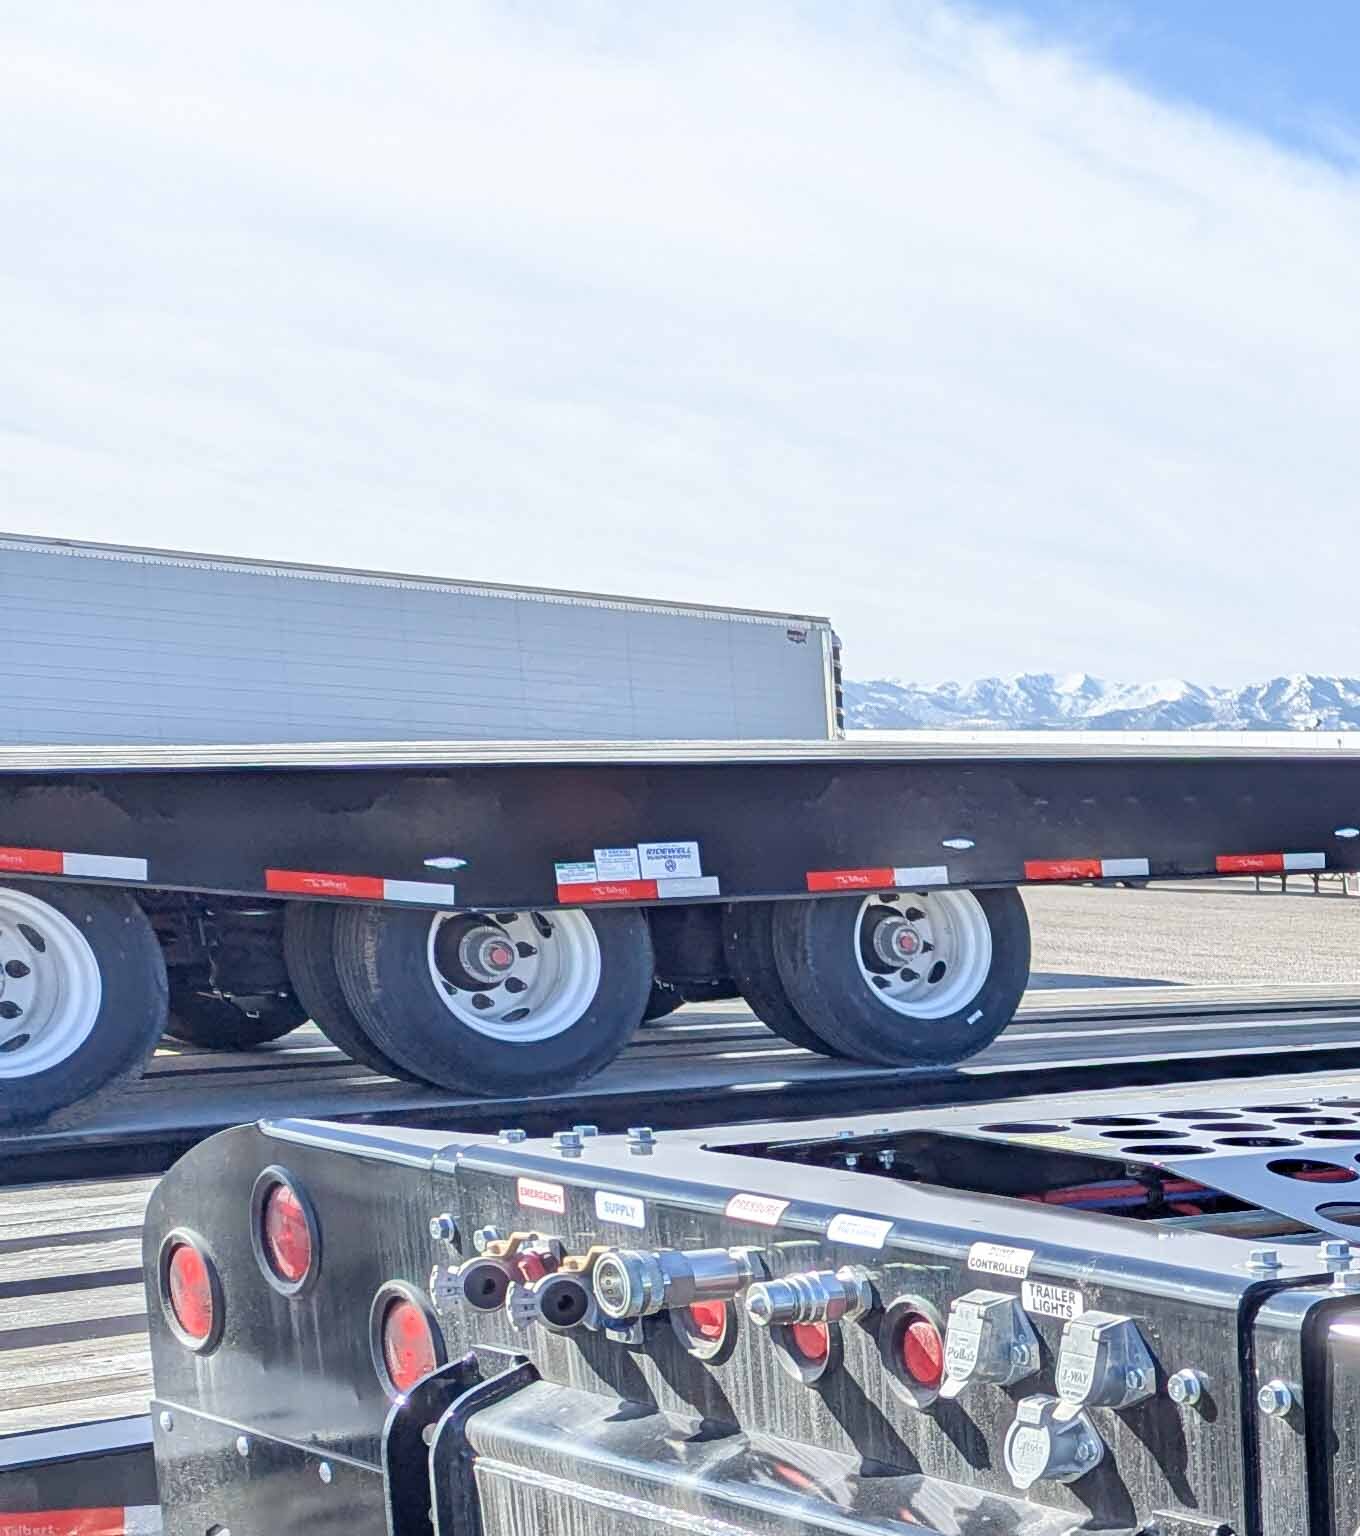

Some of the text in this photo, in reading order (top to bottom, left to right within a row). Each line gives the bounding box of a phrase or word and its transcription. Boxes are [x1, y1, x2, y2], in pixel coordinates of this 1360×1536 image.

[603, 1200, 636, 1219] SUPPLY
[969, 1255, 1027, 1276] CONTROLLER
[1028, 1283, 1077, 1305] TRAILER
[1032, 1298, 1074, 1319] LIGHTS
